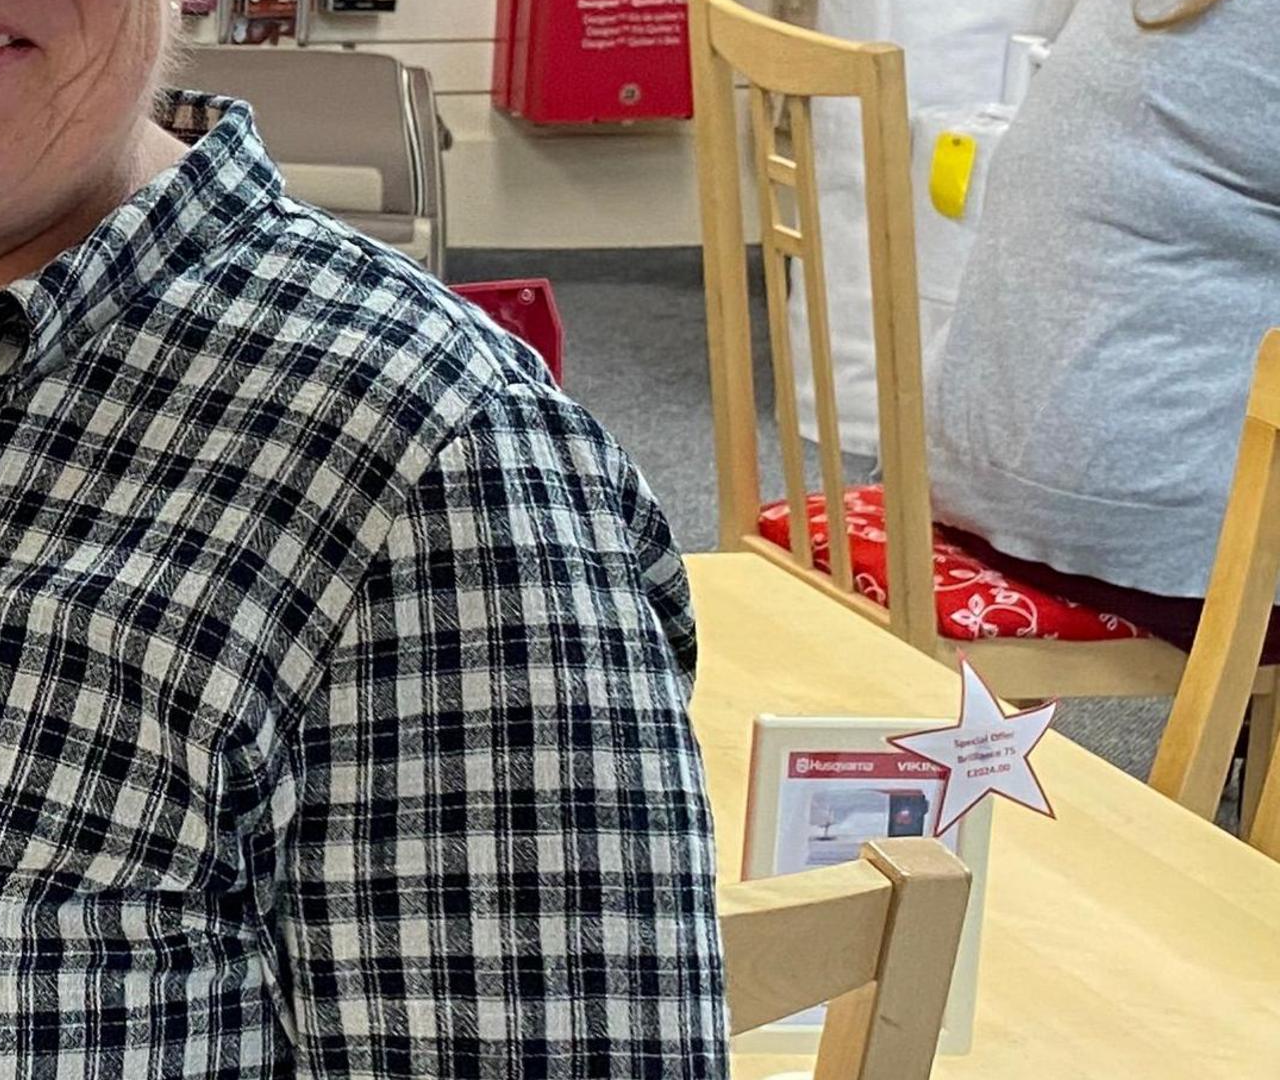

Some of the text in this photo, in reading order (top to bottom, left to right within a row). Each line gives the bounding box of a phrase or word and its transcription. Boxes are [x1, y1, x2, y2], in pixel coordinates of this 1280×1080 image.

[954, 730, 1014, 748] Special Offer
[810, 761, 942, 773] Husqvarna VIKIN
